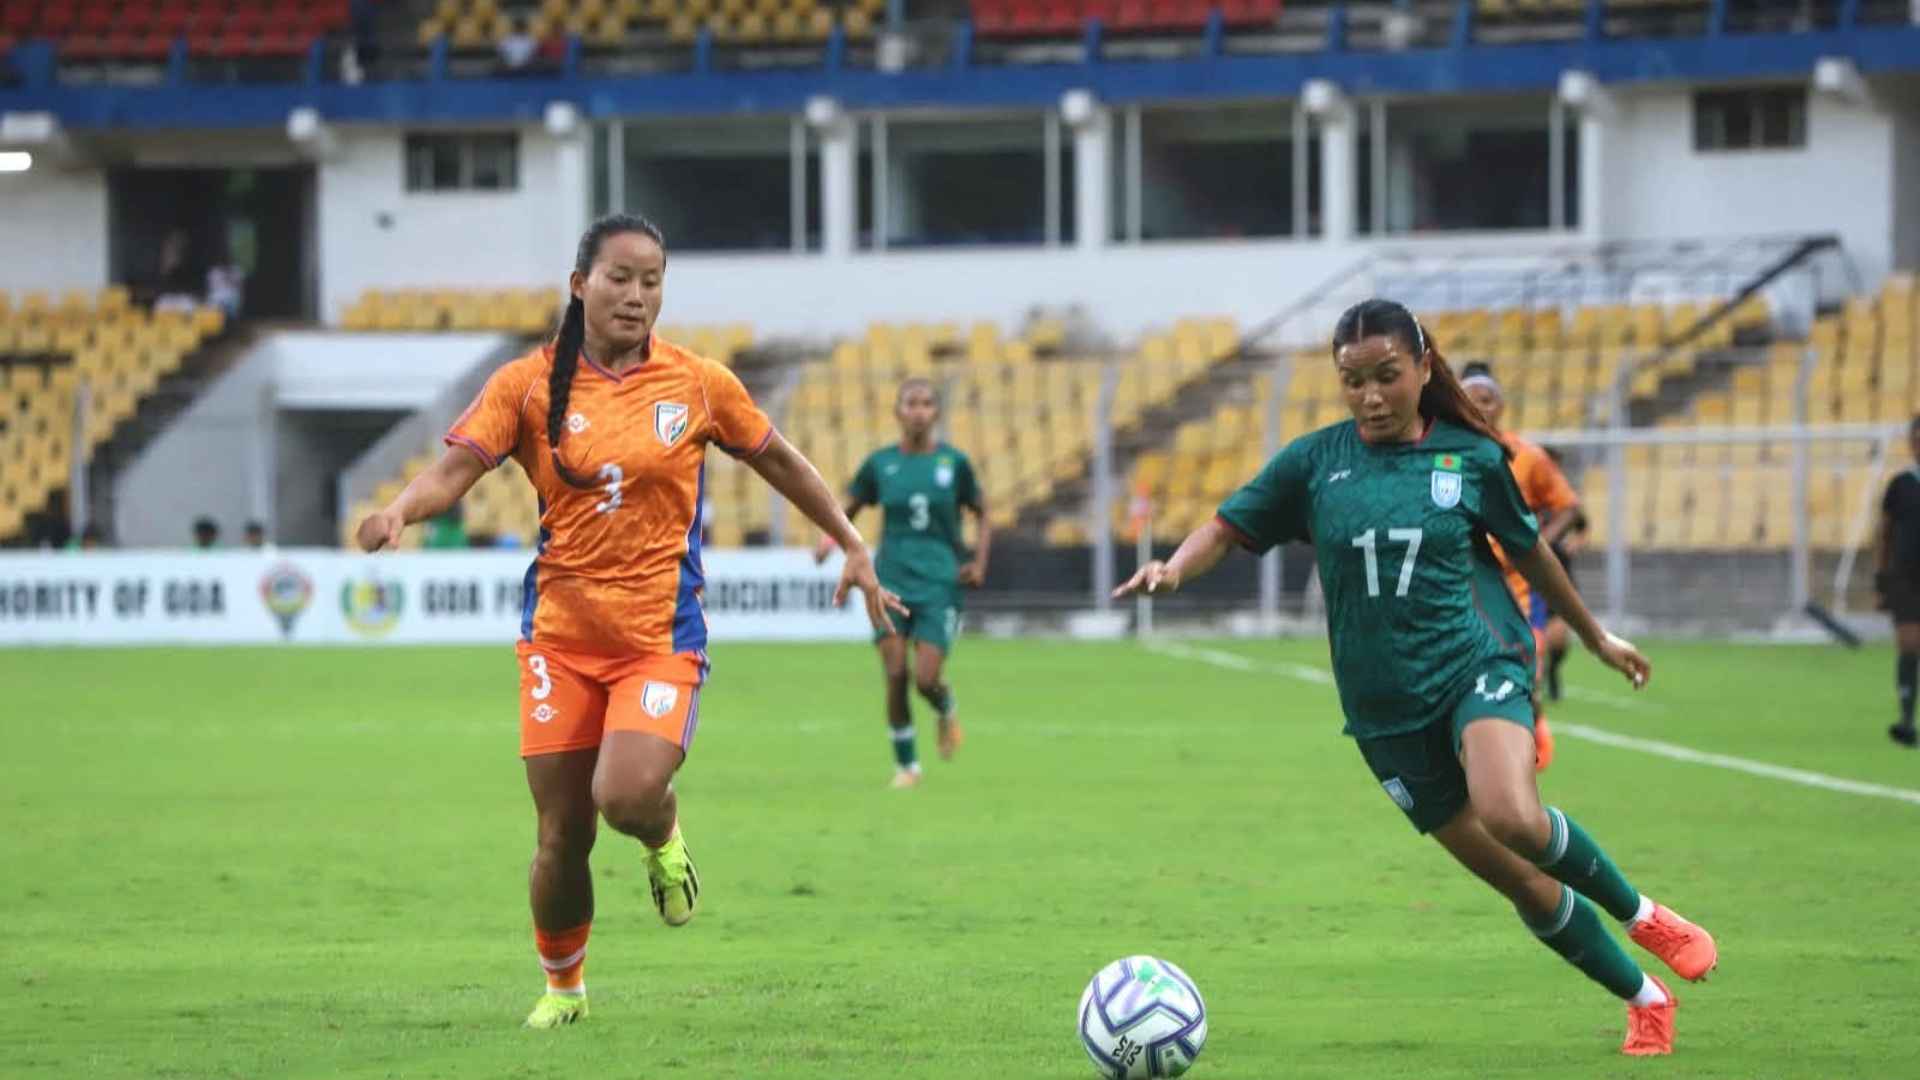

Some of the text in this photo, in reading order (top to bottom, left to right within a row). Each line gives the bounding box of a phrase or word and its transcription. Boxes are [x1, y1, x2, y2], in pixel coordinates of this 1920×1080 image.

[597, 463, 624, 513] 3
[909, 493, 930, 531] 3
[1352, 528, 1423, 597] 17
[114, 580, 149, 616] OF
[165, 580, 226, 616] GOA
[422, 580, 483, 616] GOA
[528, 655, 552, 700] 3
